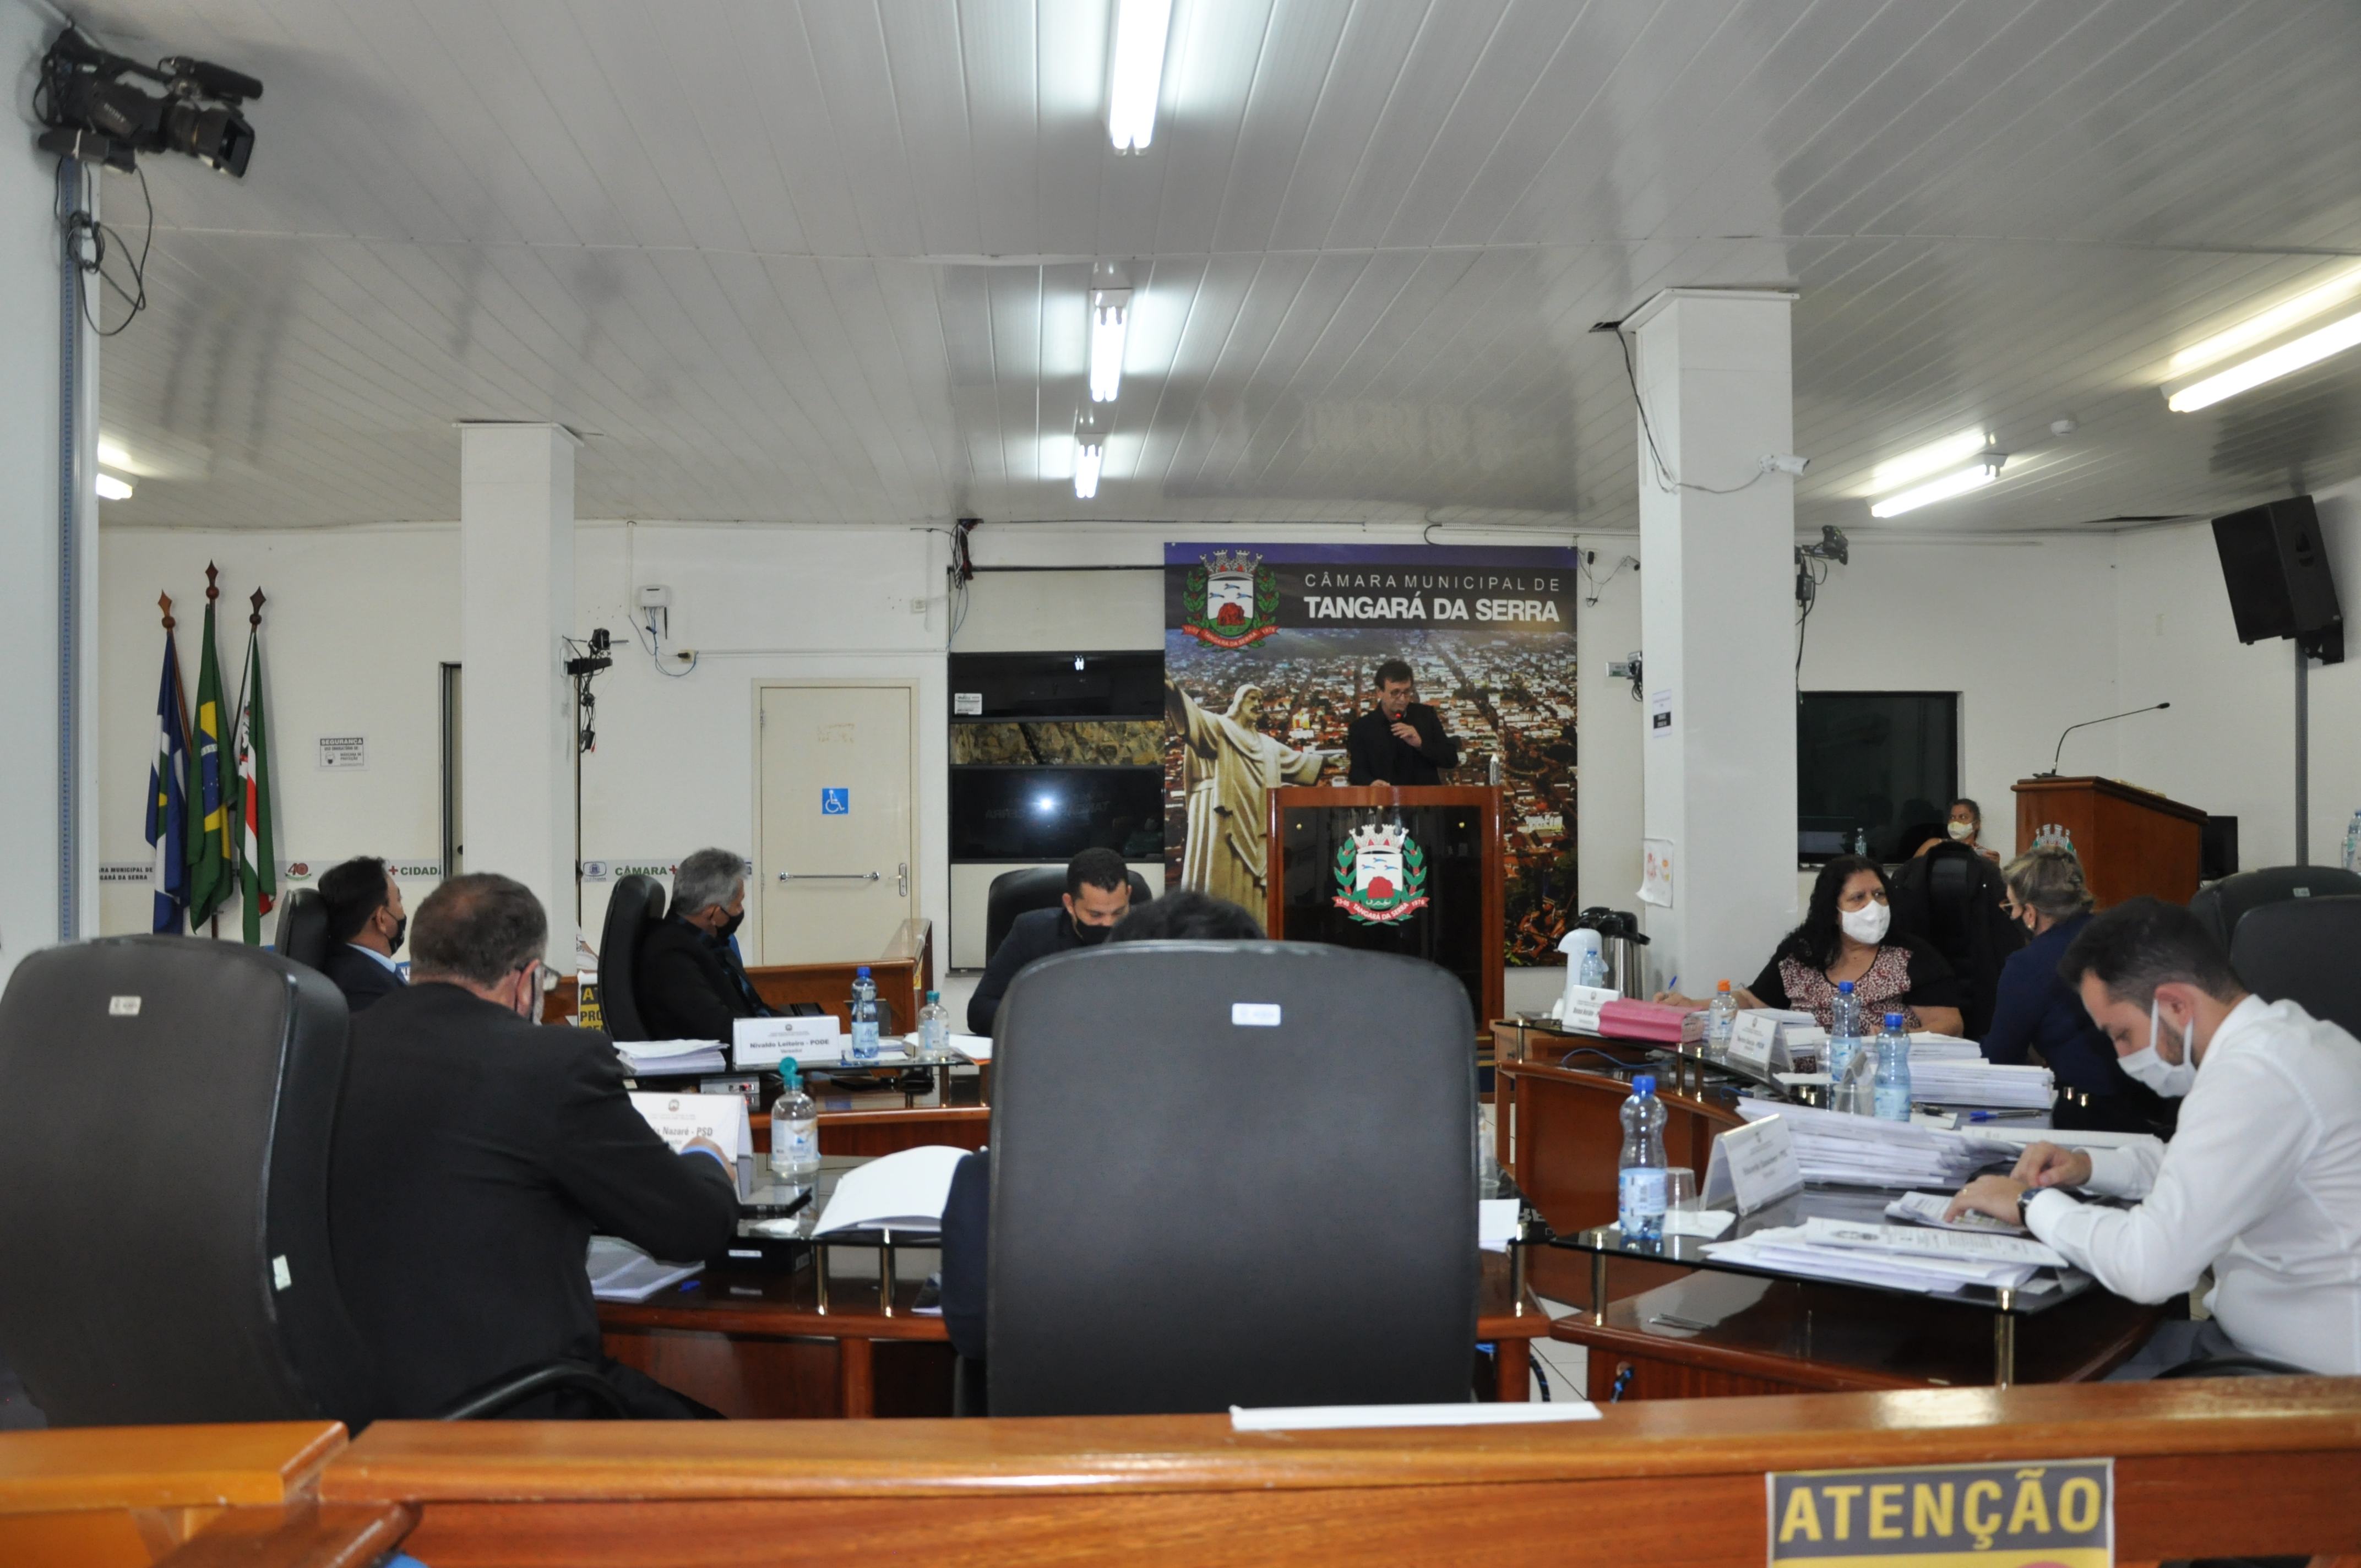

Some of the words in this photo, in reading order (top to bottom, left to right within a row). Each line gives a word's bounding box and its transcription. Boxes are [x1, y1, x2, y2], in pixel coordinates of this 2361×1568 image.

[1305, 571, 1397, 588] CÂMARA
[1405, 576, 1525, 591] MUNICIPAL
[1534, 578, 1560, 592] DE
[1304, 591, 1427, 619] TANGARÁ
[1434, 598, 1468, 620] DA
[1475, 599, 1560, 622] SERRA
[1352, 903, 1381, 921] TANGARÁ
[1392, 902, 1409, 917] SERRA
[1411, 899, 1425, 907] 1976
[662, 1126, 689, 1136] Nazaré
[696, 1126, 714, 1136] PSD
[1778, 1467, 2102, 1550] ATENÇÃO
